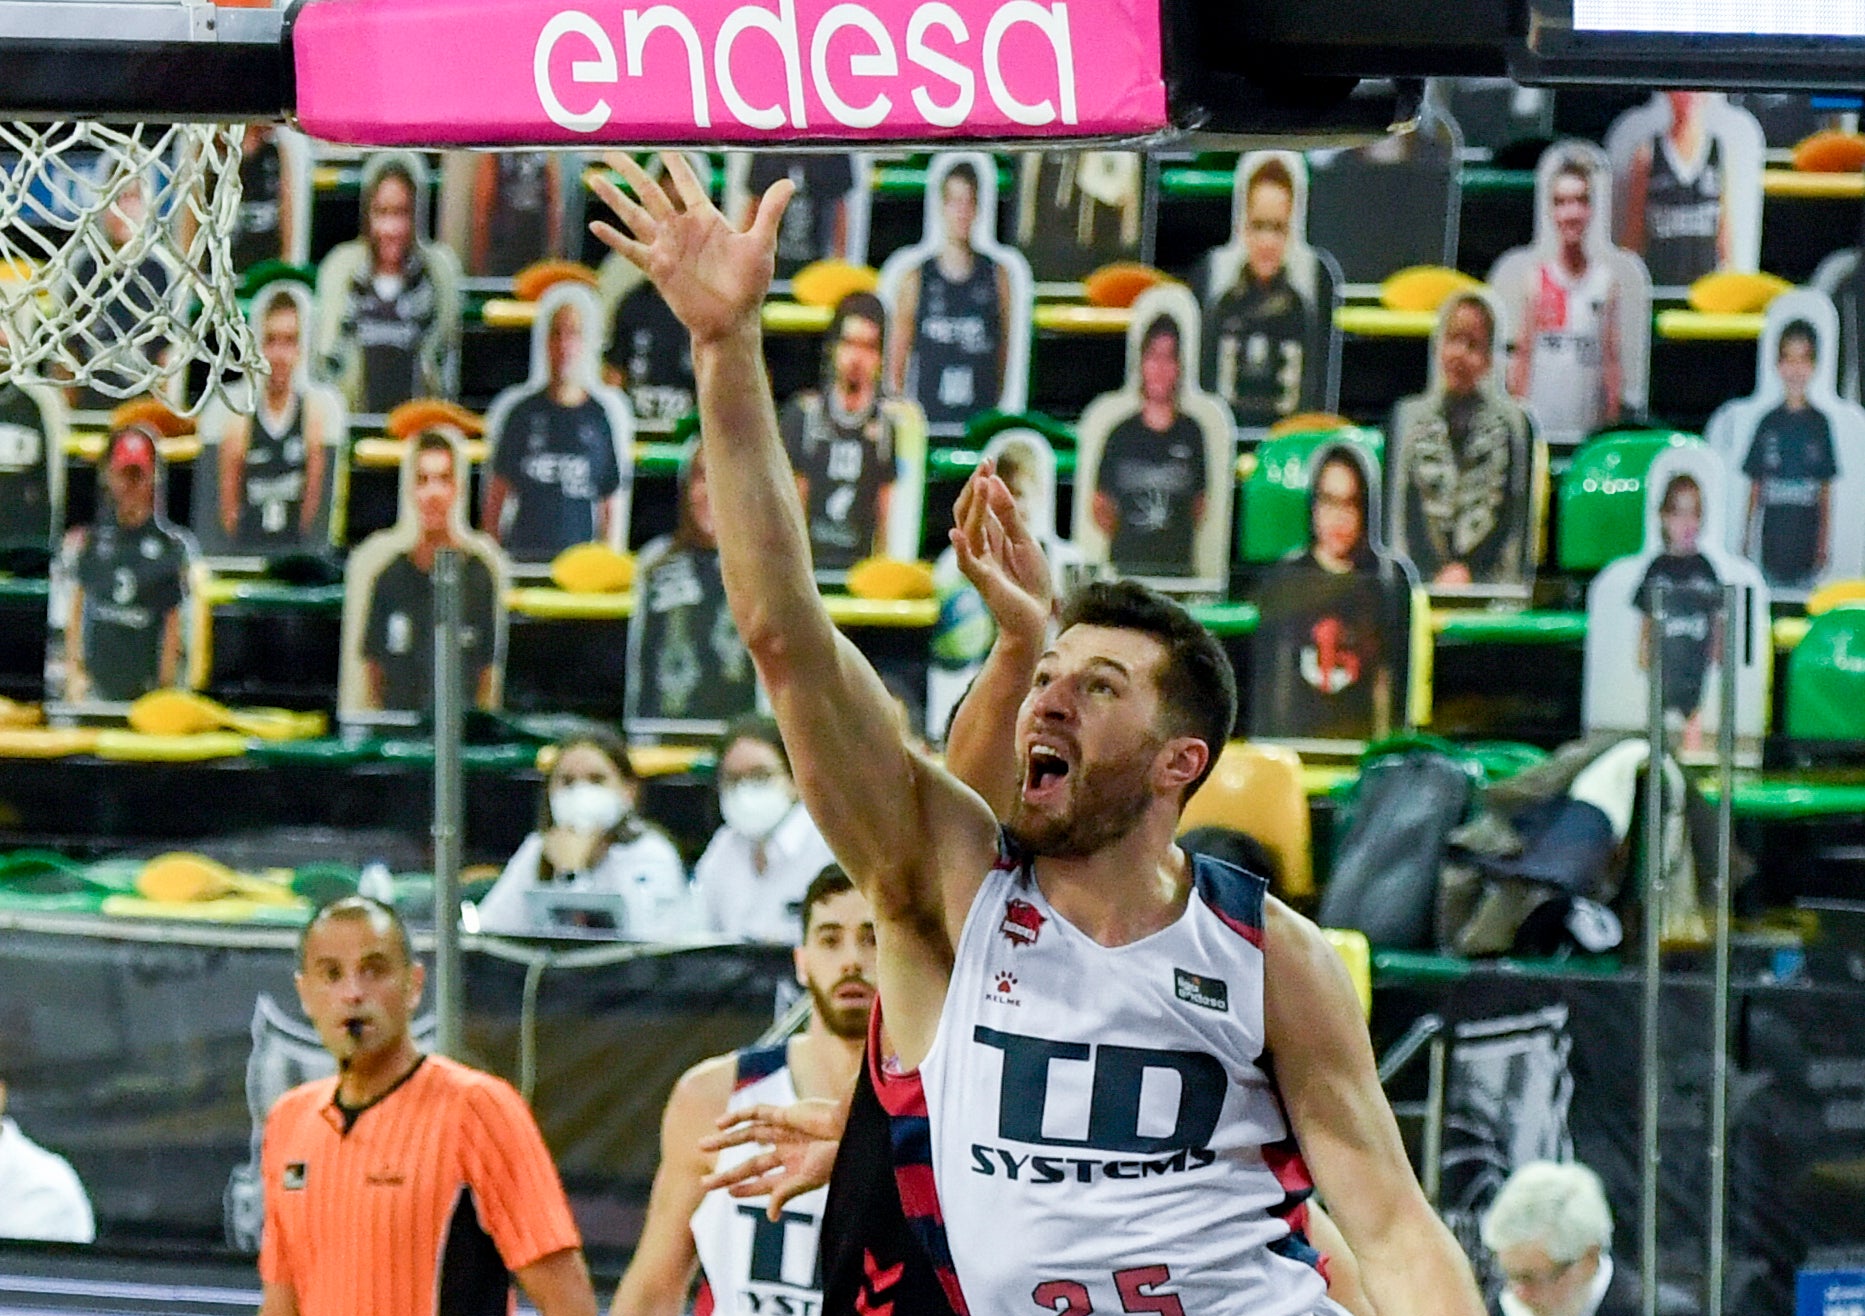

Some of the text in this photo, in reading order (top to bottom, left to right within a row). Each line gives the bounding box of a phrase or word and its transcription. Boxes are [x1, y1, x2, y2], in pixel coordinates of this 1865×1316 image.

[533, 0, 1078, 132] endesa
[973, 1024, 1229, 1154] TD
[736, 1204, 823, 1291] T
